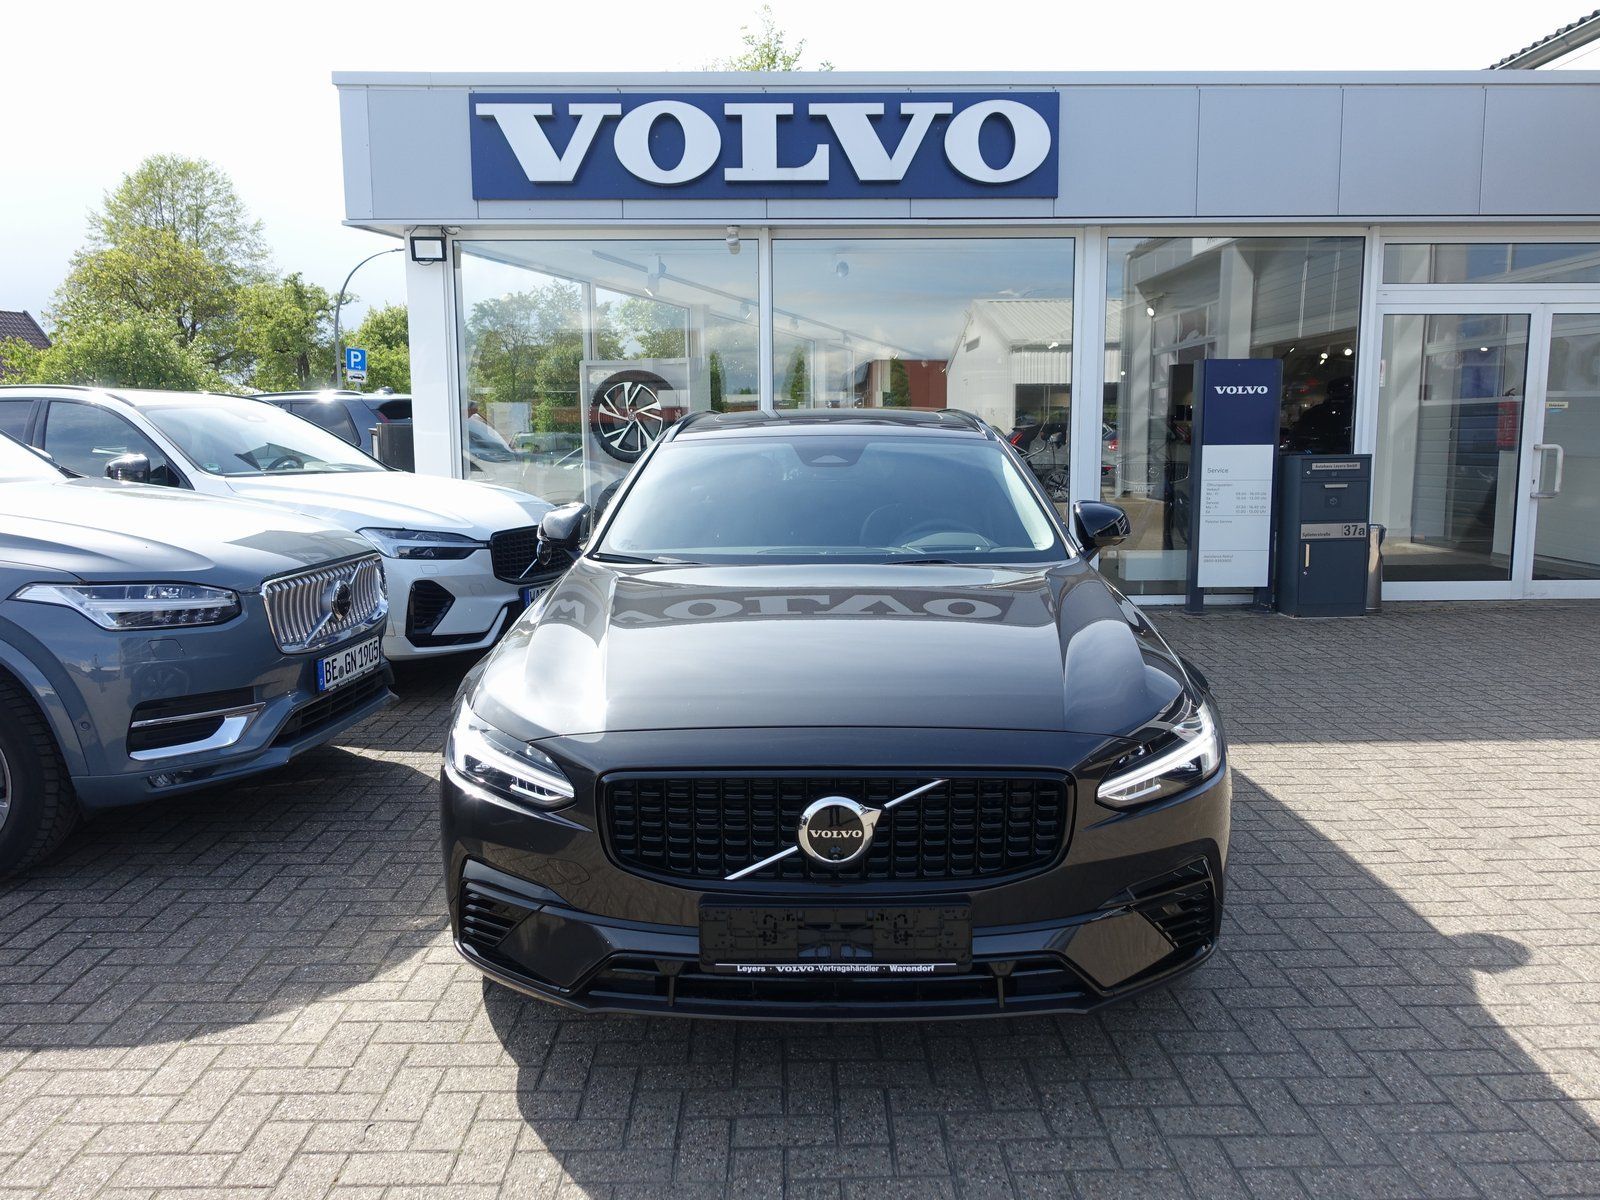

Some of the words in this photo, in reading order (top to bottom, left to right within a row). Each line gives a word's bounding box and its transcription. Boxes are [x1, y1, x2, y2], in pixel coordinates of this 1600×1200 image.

[475, 99, 1052, 185] VOLVO
[350, 350, 362, 368] P
[1214, 385, 1269, 395] VOLVO
[1343, 524, 1365, 536] 37a
[324, 658, 339, 685] BE
[344, 649, 358, 675] GN
[358, 640, 379, 668] 1905
[809, 829, 863, 838] VOLVO
[736, 965, 766, 973] Leyers
[889, 964, 935, 973] Warendorf
